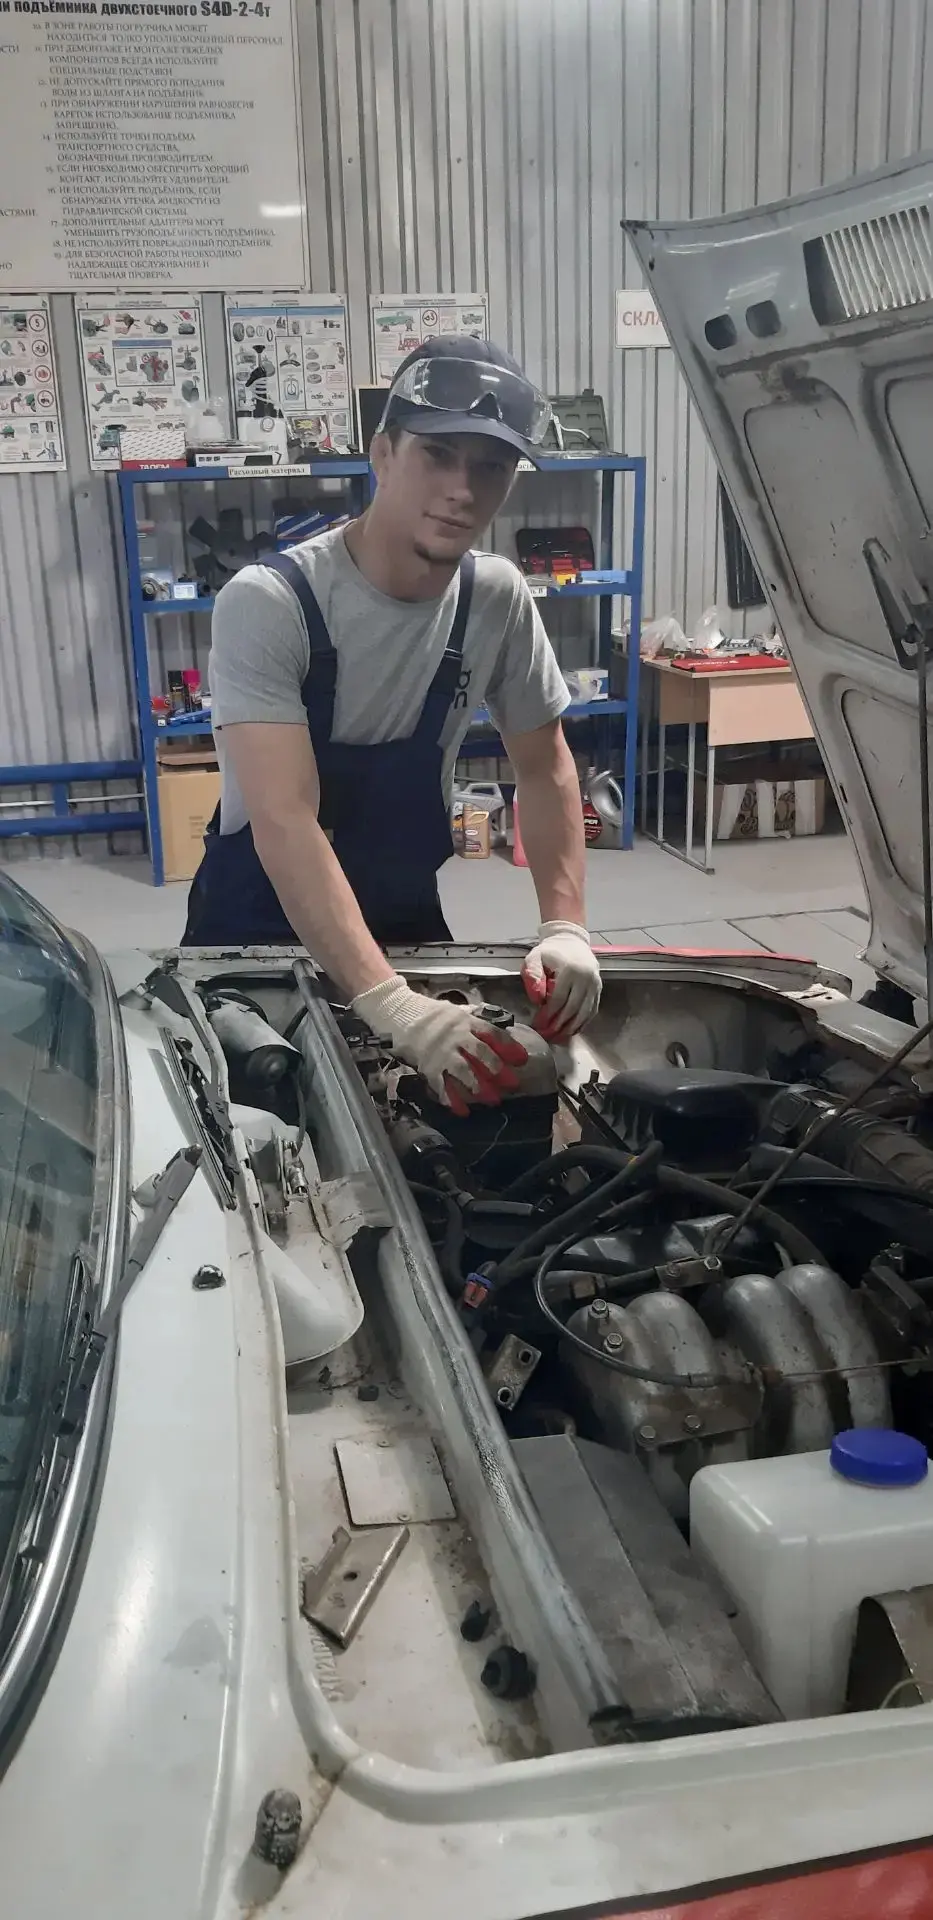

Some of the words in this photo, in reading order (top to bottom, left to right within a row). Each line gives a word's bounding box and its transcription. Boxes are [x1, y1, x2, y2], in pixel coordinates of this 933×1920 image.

[15, 0, 97, 14] ПОДЪЁМНИКА
[101, 3, 197, 16] ДВУХСТОЕЧНОГО
[78, 23, 114, 31] РАБОТЫ
[117, 23, 172, 32] ПОГРУЗЧИКА
[175, 24, 208, 32] МОЖЕТ
[47, 33, 107, 42] НАХОДИТЬСЯ
[45, 45, 63, 53] ПРИ
[66, 45, 122, 54] ДЕМОНТАЖЕ
[133, 45, 179, 54] МОНТАЖЕ
[49, 55, 118, 64] КОМПОНЕНТОВ
[121, 56, 152, 65] ВСЕГДА
[155, 56, 218, 66] ИСПОЛЬЗУЙТЕ
[50, 66, 116, 75] СПЕЦИАЛЬНЫЕ
[49, 77, 60, 85] НЕ
[64, 76, 121, 86] ДОПУСКАЙТЕ
[125, 78, 167, 86] ПРЯМОГО
[169, 78, 225, 87] ПОПАДАНИЯ
[52, 88, 78, 97] ВОДЫ
[80, 89, 91, 97] ИЗ
[93, 89, 131, 97] ШЛАНГА
[134, 89, 146, 97] НА
[51, 99, 69, 107] ПРИ
[72, 99, 139, 108] ОБНАРУЖЕНИИ
[142, 100, 196, 108] НАРУШЕНИЯ
[199, 100, 254, 109] РАВНОВЕСИЯ
[54, 110, 93, 118] КАРЕТОК
[95, 110, 171, 119] ИСПОЛЬЗОВАНИЕ
[54, 131, 118, 140] ИСПОЛЬЗУЙТЕ
[120, 132, 150, 140] ТОЧКИ
[57, 143, 133, 151] ТРАНСПОРТНОГО
[57, 164, 80, 173] ЕСЛИ
[82, 165, 145, 173] НЕОБХОДИМО
[147, 165, 203, 173] ОБЕСПЕЧИТЬ
[204, 164, 249, 173] ХОРОШИЙ
[105, 174, 167, 183] ИСПОЛЬЗУЙТЕ
[60, 186, 73, 194] НЕ
[73, 185, 136, 194] ИСПОЛЬЗУЙТЕ
[61, 197, 121, 205] ОБНАРУЖЕНА
[123, 197, 156, 205] УТЕЧКА
[157, 197, 208, 206] ЖИДКОСТИ
[209, 197, 221, 205] ИЗ
[63, 207, 142, 216] ГИДРАВЛИЧЕСКОЙ
[62, 218, 146, 227] ДОПОЛНИТЕЛЬНЫЕ
[195, 218, 224, 226] МОГУТ
[64, 228, 119, 237] УМЕНЬШИТЬ
[64, 239, 76, 247] НЕ
[77, 238, 140, 248] ИСПОЛЬЗУЙТЕ
[65, 250, 83, 259] ДЛЯ
[85, 249, 142, 258] БЕЗОПАСНОЙ
[145, 250, 179, 258] РАБОТЫ
[181, 250, 242, 259] НЕОБХОДИМО
[67, 260, 128, 269] НАДЛЕЖАЩЕЕ
[130, 260, 201, 269] ОБСЛУЖИВАНИЕ
[203, 260, 209, 268] И
[69, 271, 126, 280] ТЩАТЕЛЬНАЯ
[229, 467, 269, 476] Расходный
[270, 467, 305, 475] материал
